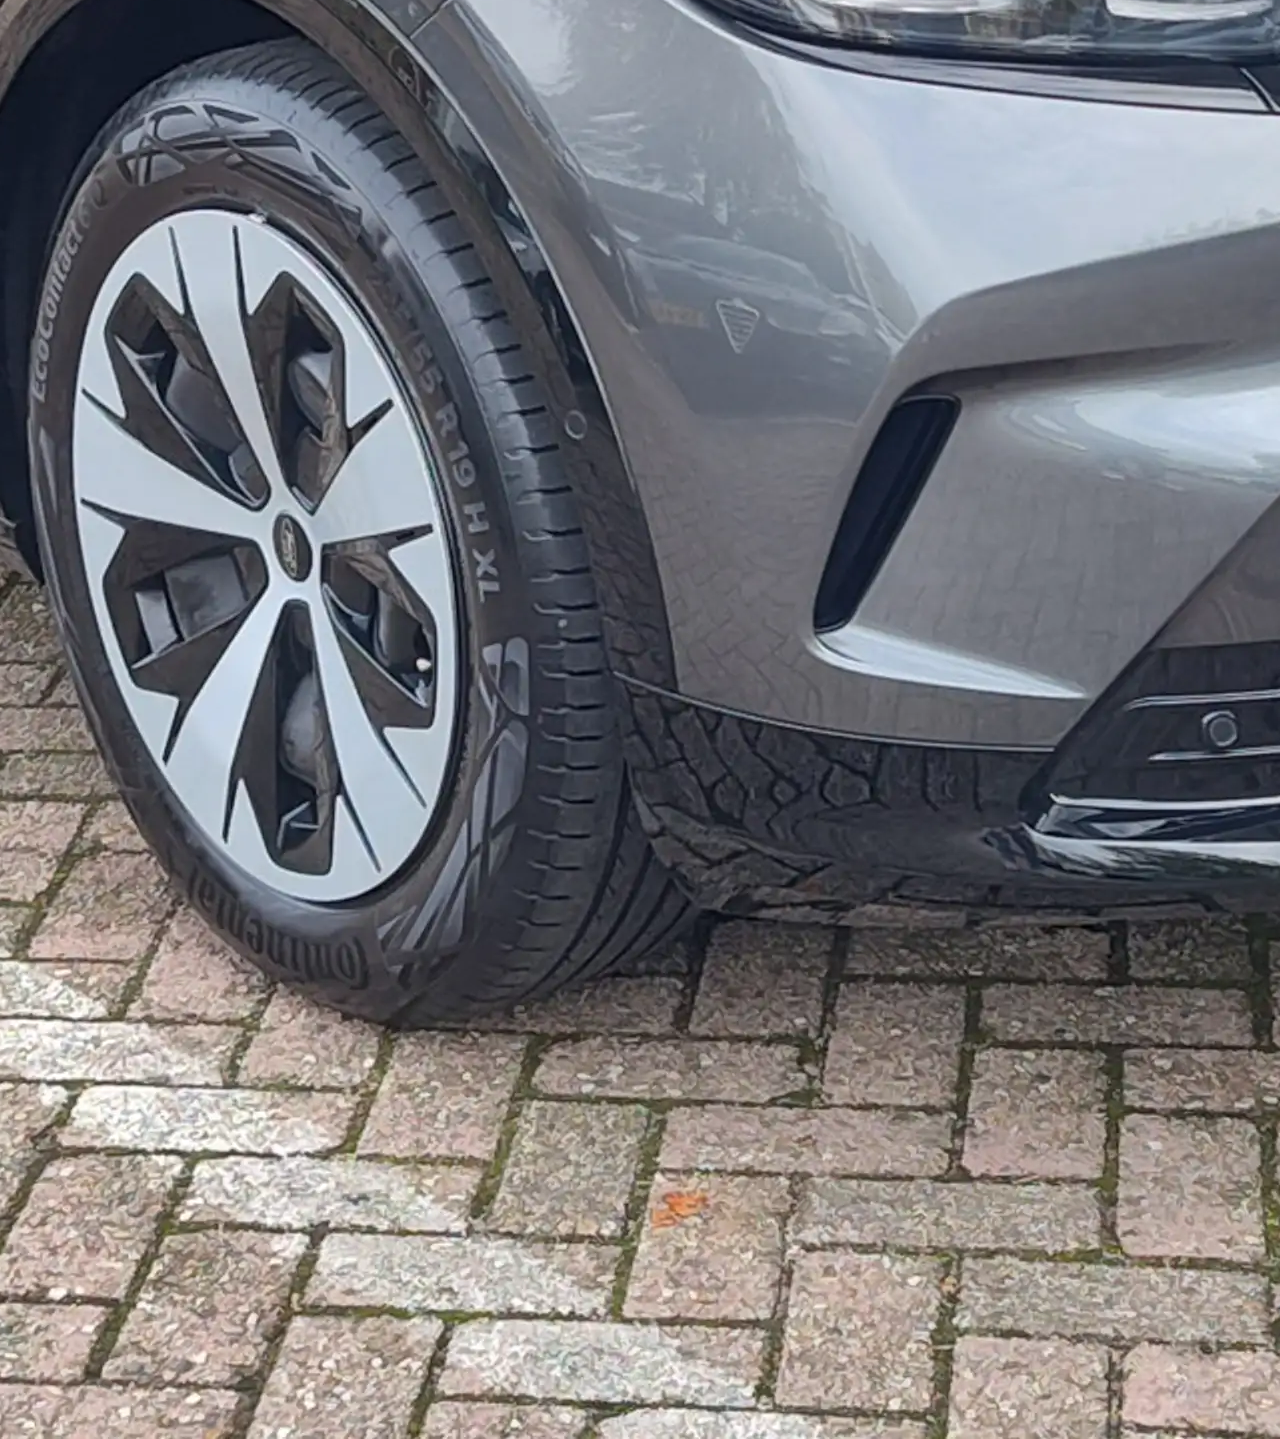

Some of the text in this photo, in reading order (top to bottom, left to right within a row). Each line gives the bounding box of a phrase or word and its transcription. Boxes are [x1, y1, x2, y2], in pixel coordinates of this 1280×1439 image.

[30, 217, 84, 403] EcoContact
[434, 401, 477, 489] R19
[462, 502, 490, 535] H
[472, 546, 502, 605] XL
[186, 867, 370, 991] Continental
